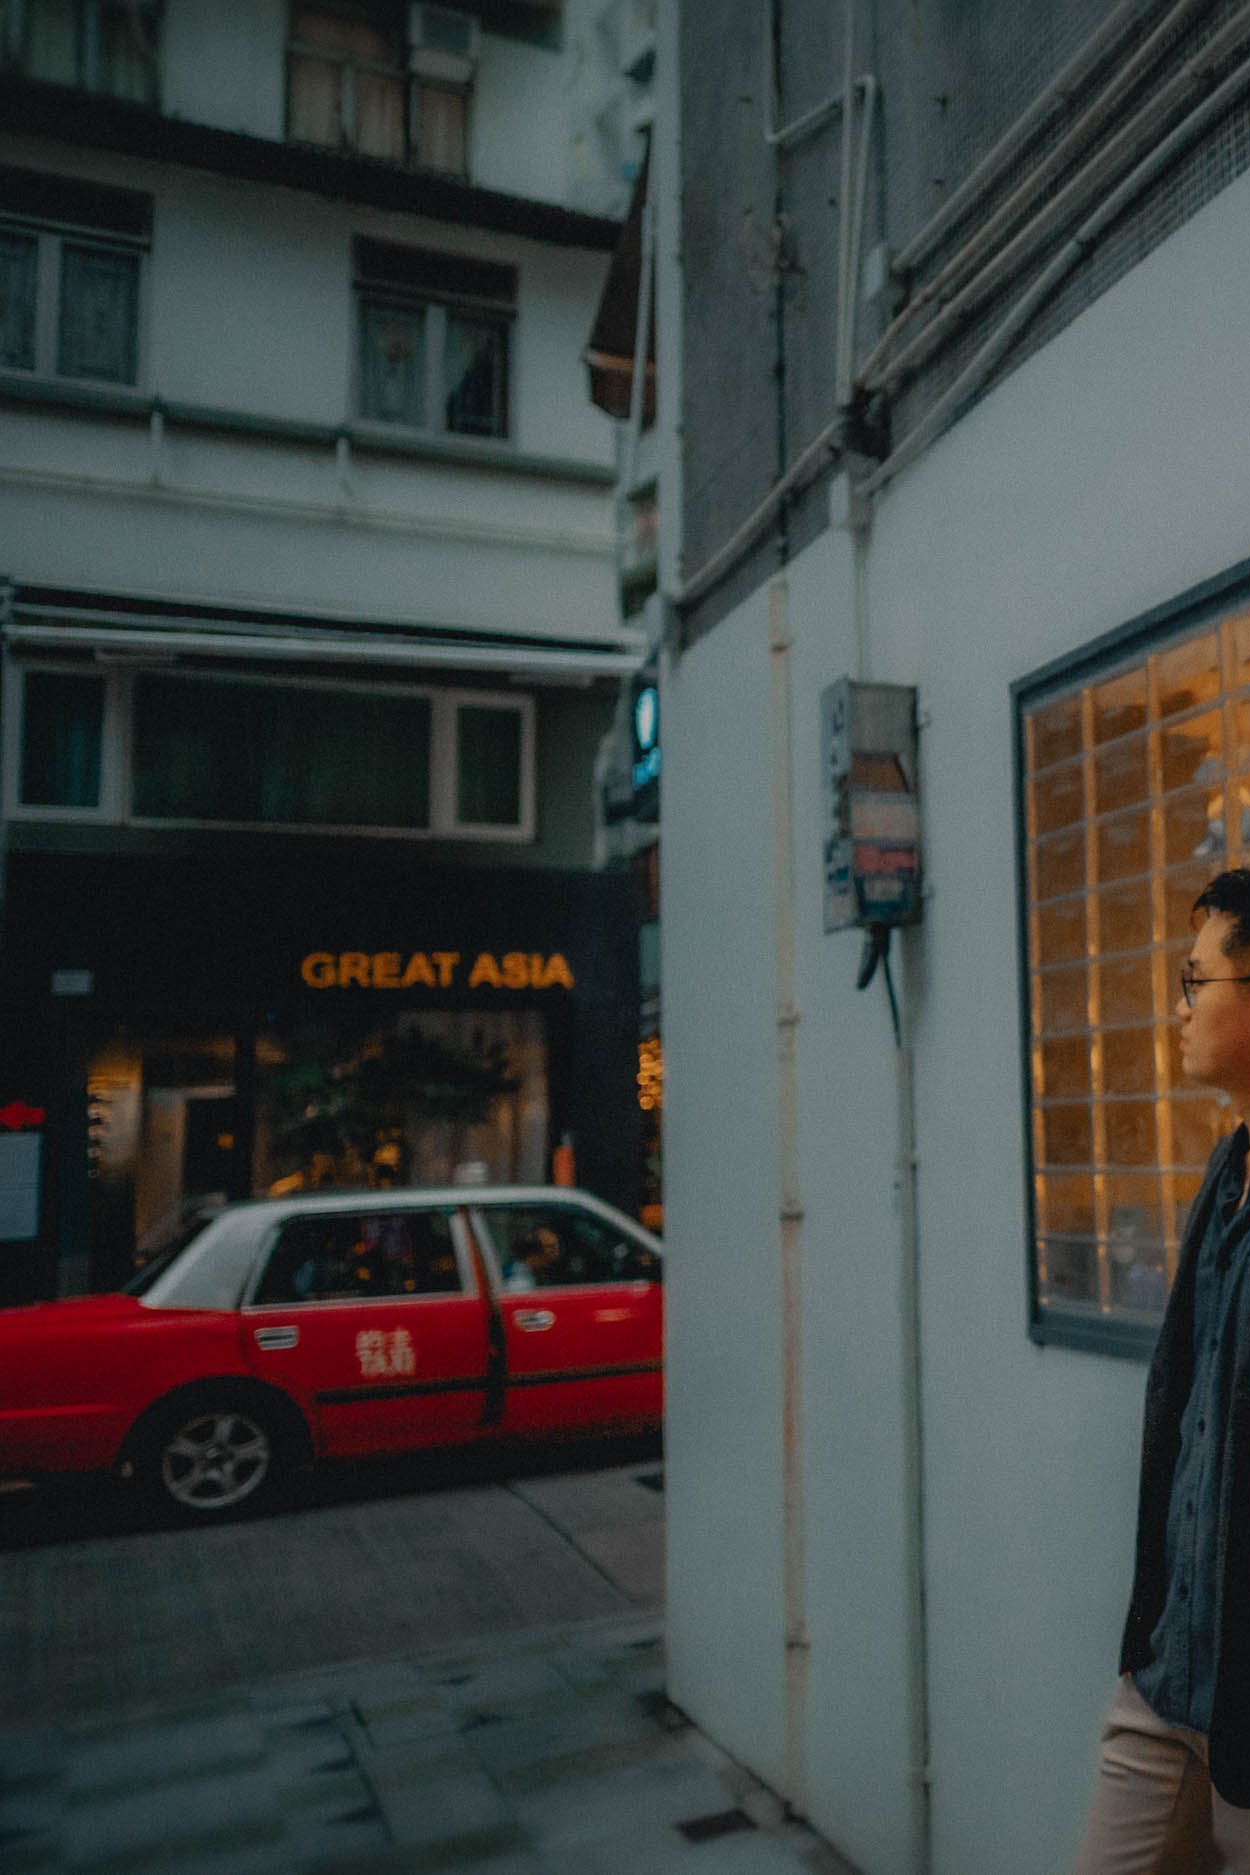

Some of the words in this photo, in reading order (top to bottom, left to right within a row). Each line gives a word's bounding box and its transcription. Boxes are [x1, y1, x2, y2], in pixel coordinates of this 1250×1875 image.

[301, 952, 459, 988] GREAT
[469, 952, 573, 989] ASIA
[357, 1350, 415, 1376] TAXI
